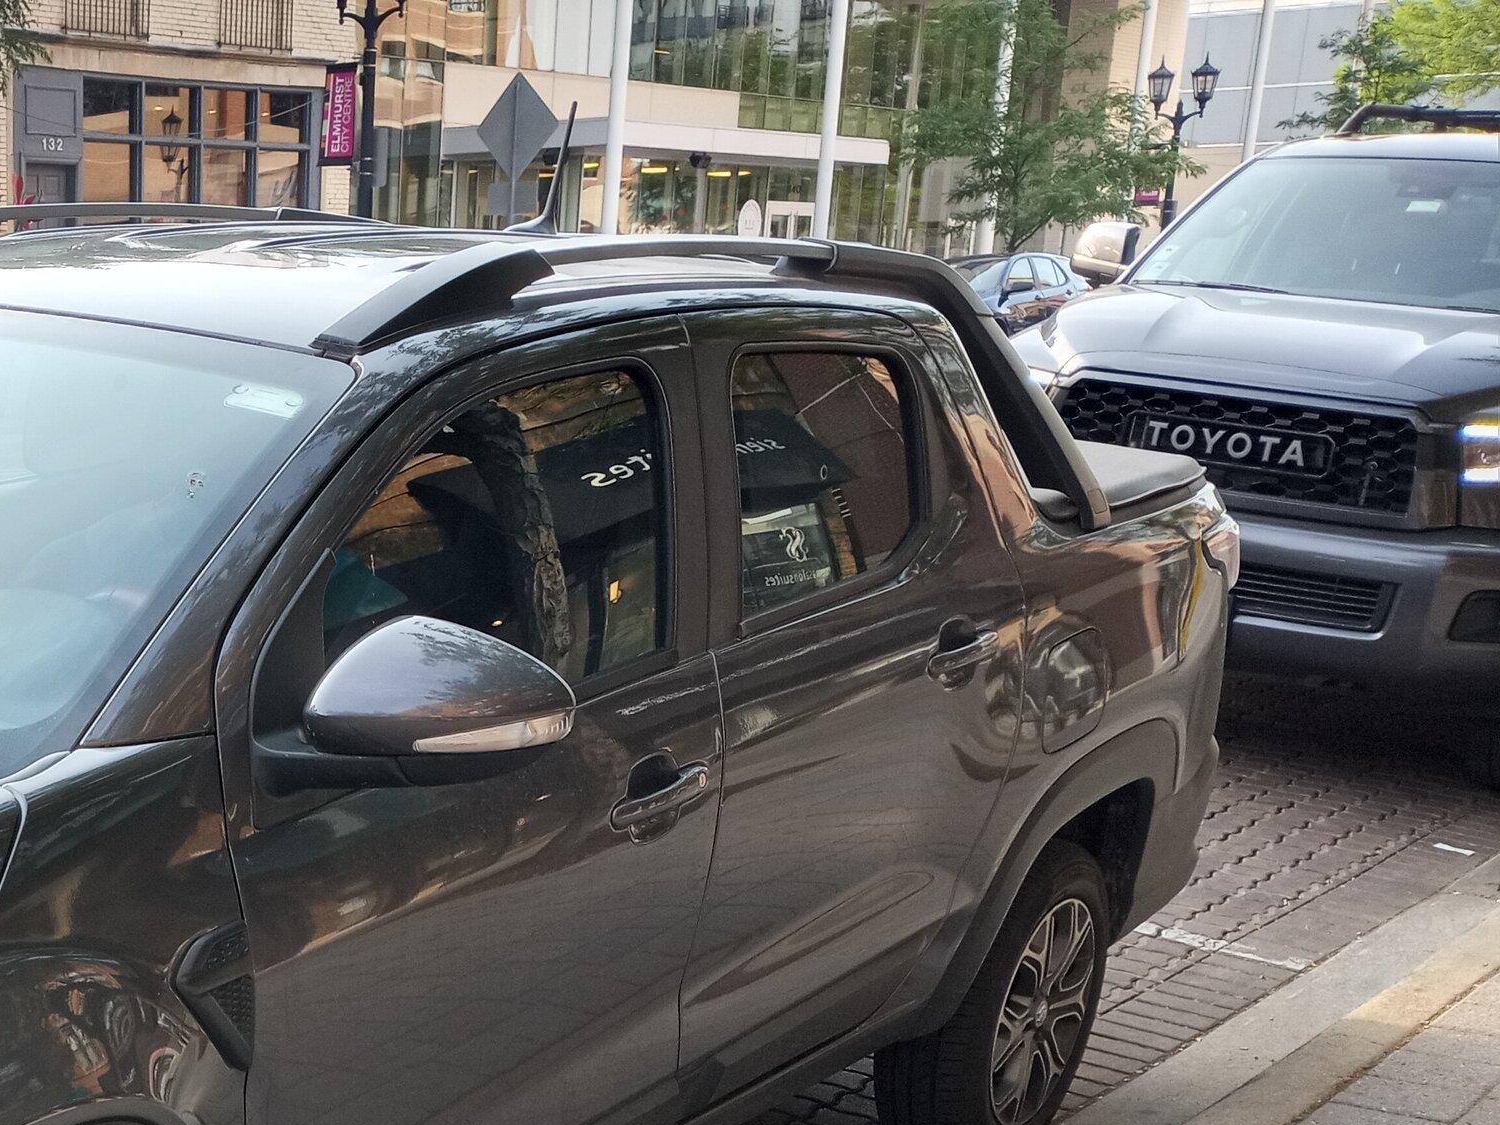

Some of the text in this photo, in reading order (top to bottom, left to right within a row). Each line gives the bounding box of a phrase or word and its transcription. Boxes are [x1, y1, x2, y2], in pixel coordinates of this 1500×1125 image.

[42, 137, 63, 151] 132
[331, 76, 345, 152] ELMHURST
[340, 76, 353, 153] CITY CENTRE
[1149, 420, 1305, 467] TOYOTA
